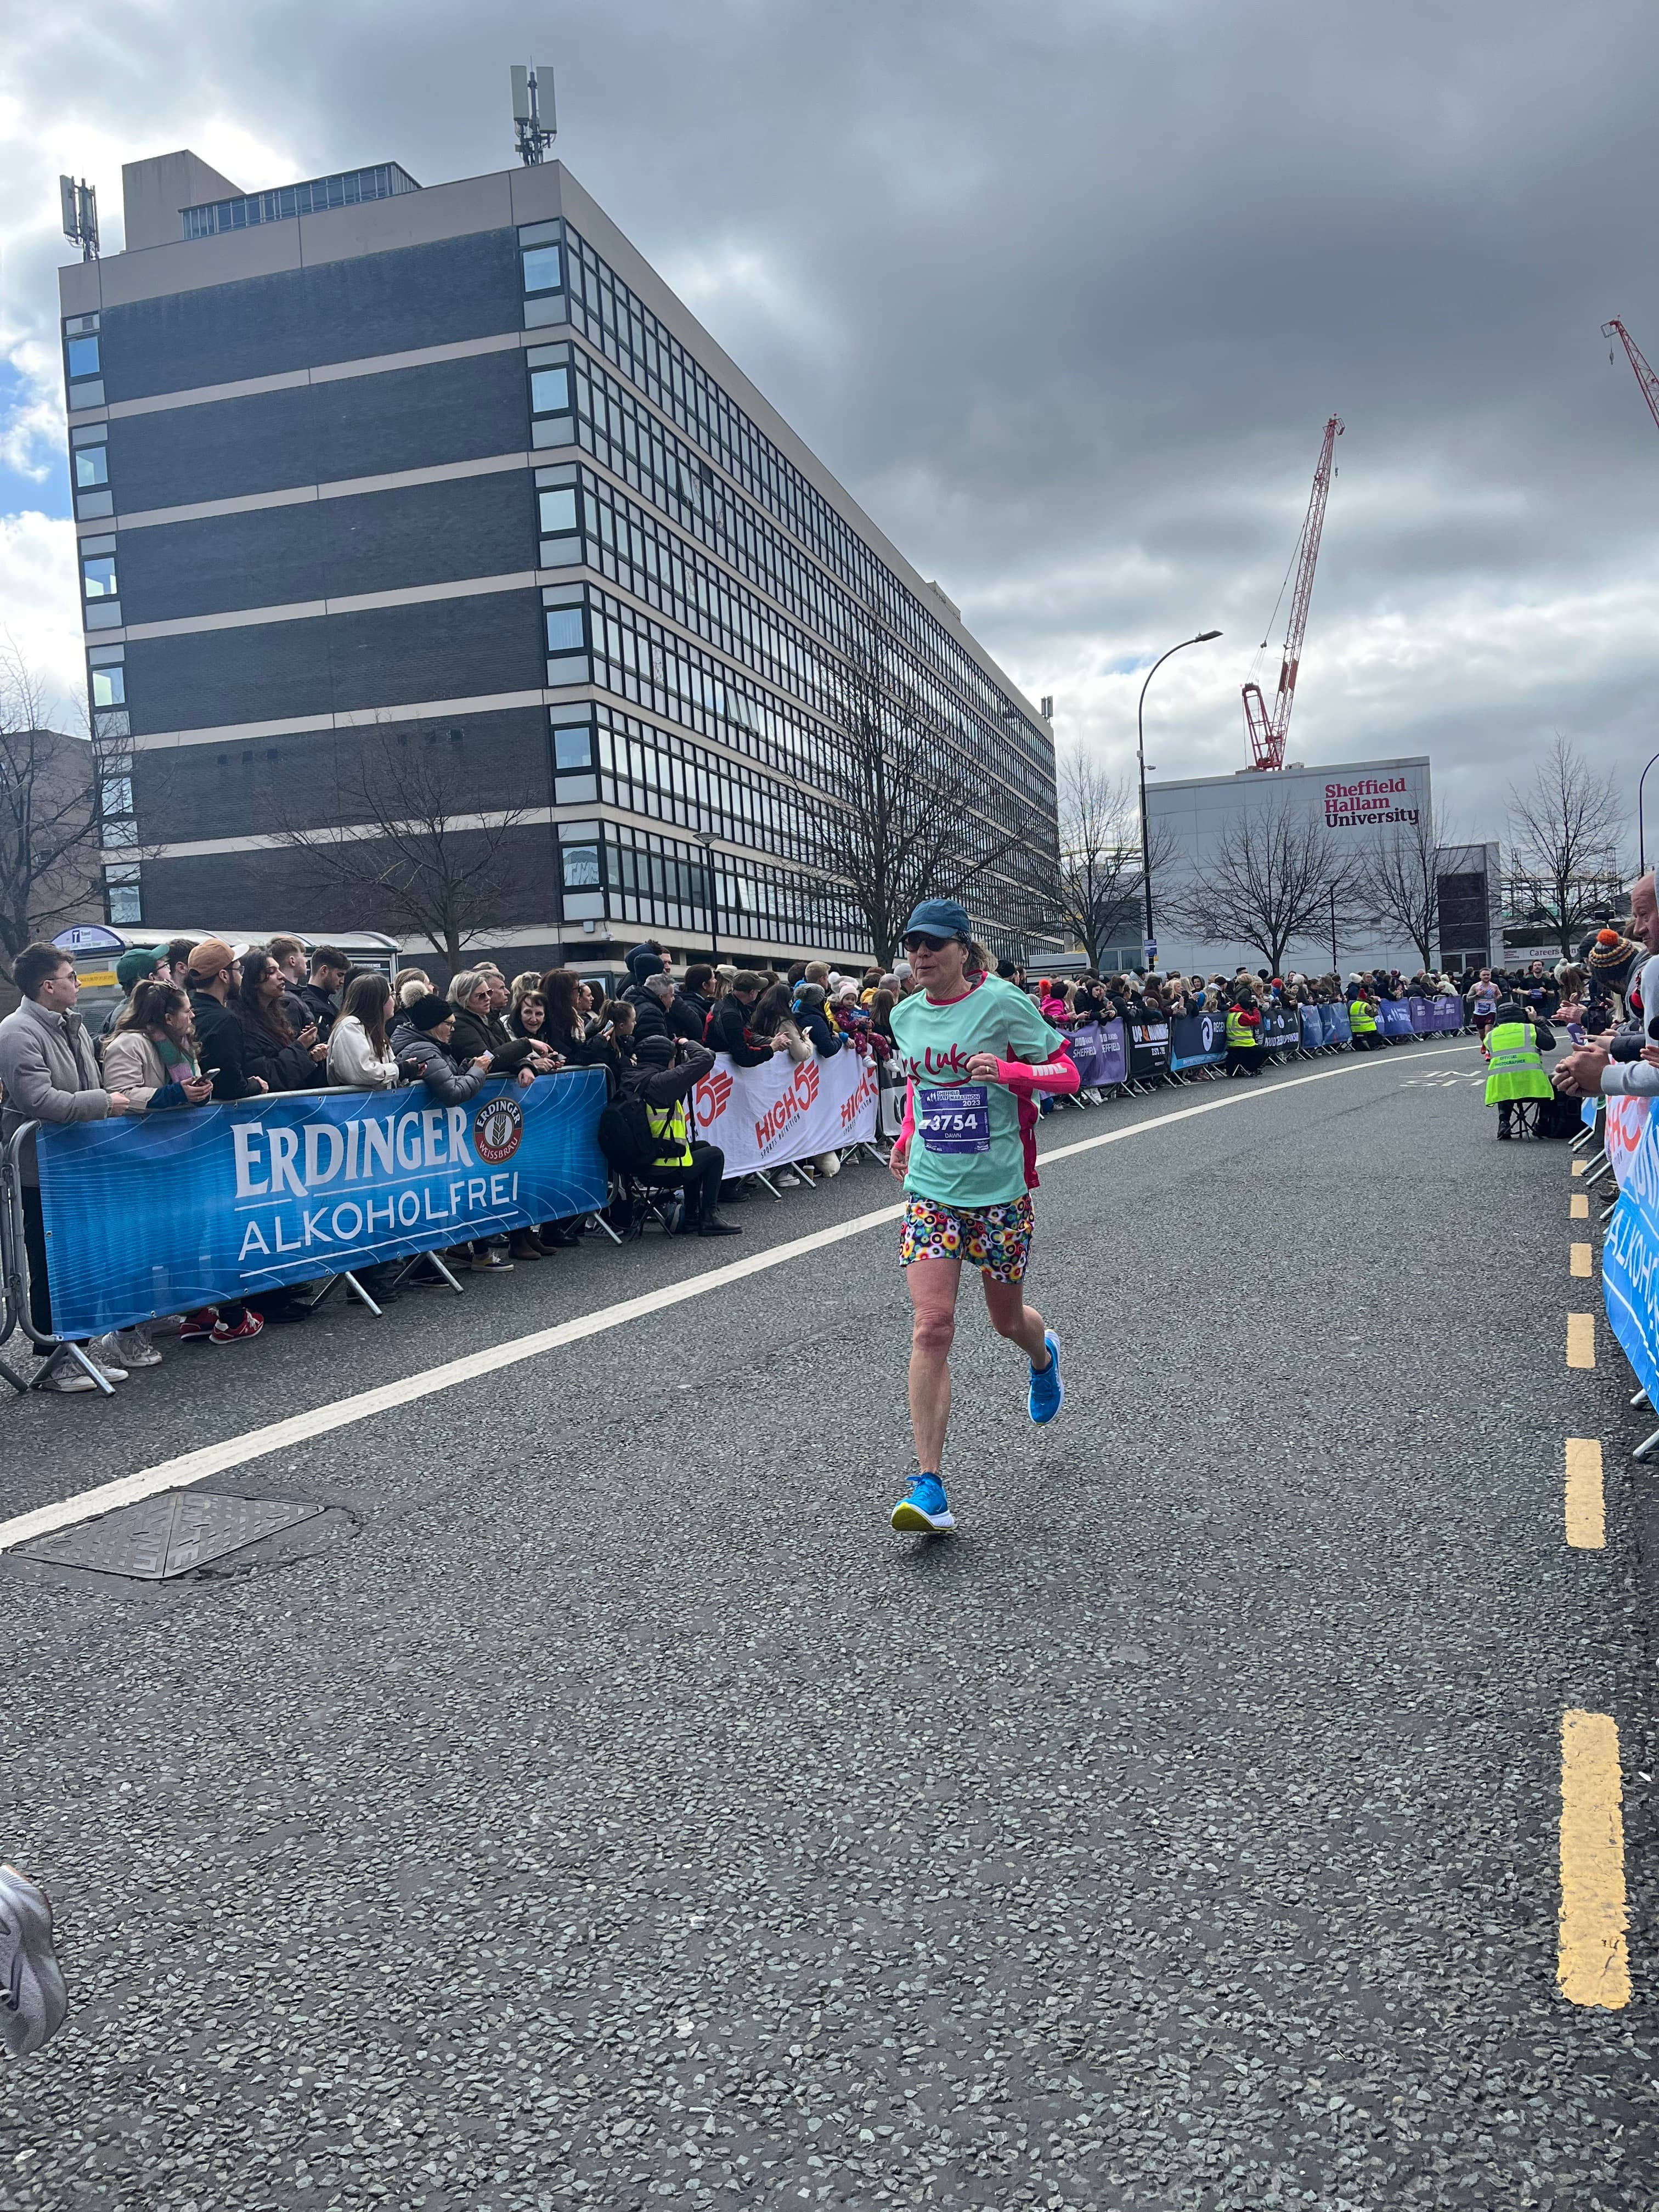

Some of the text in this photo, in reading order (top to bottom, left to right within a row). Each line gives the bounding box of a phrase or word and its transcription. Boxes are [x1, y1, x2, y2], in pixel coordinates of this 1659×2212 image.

[1325, 777, 1407, 798] Sheffield
[1324, 797, 1390, 813] Hallam
[1325, 808, 1419, 827] University
[1073, 1046, 1097, 1058] SHEFFIELD
[476, 1101, 521, 1127] ERDINGER
[760, 1113, 800, 1159] SPORTS NUTRITION
[230, 1106, 474, 1199] ERDINGER
[239, 1171, 519, 1261] ALKOHOLFREI
